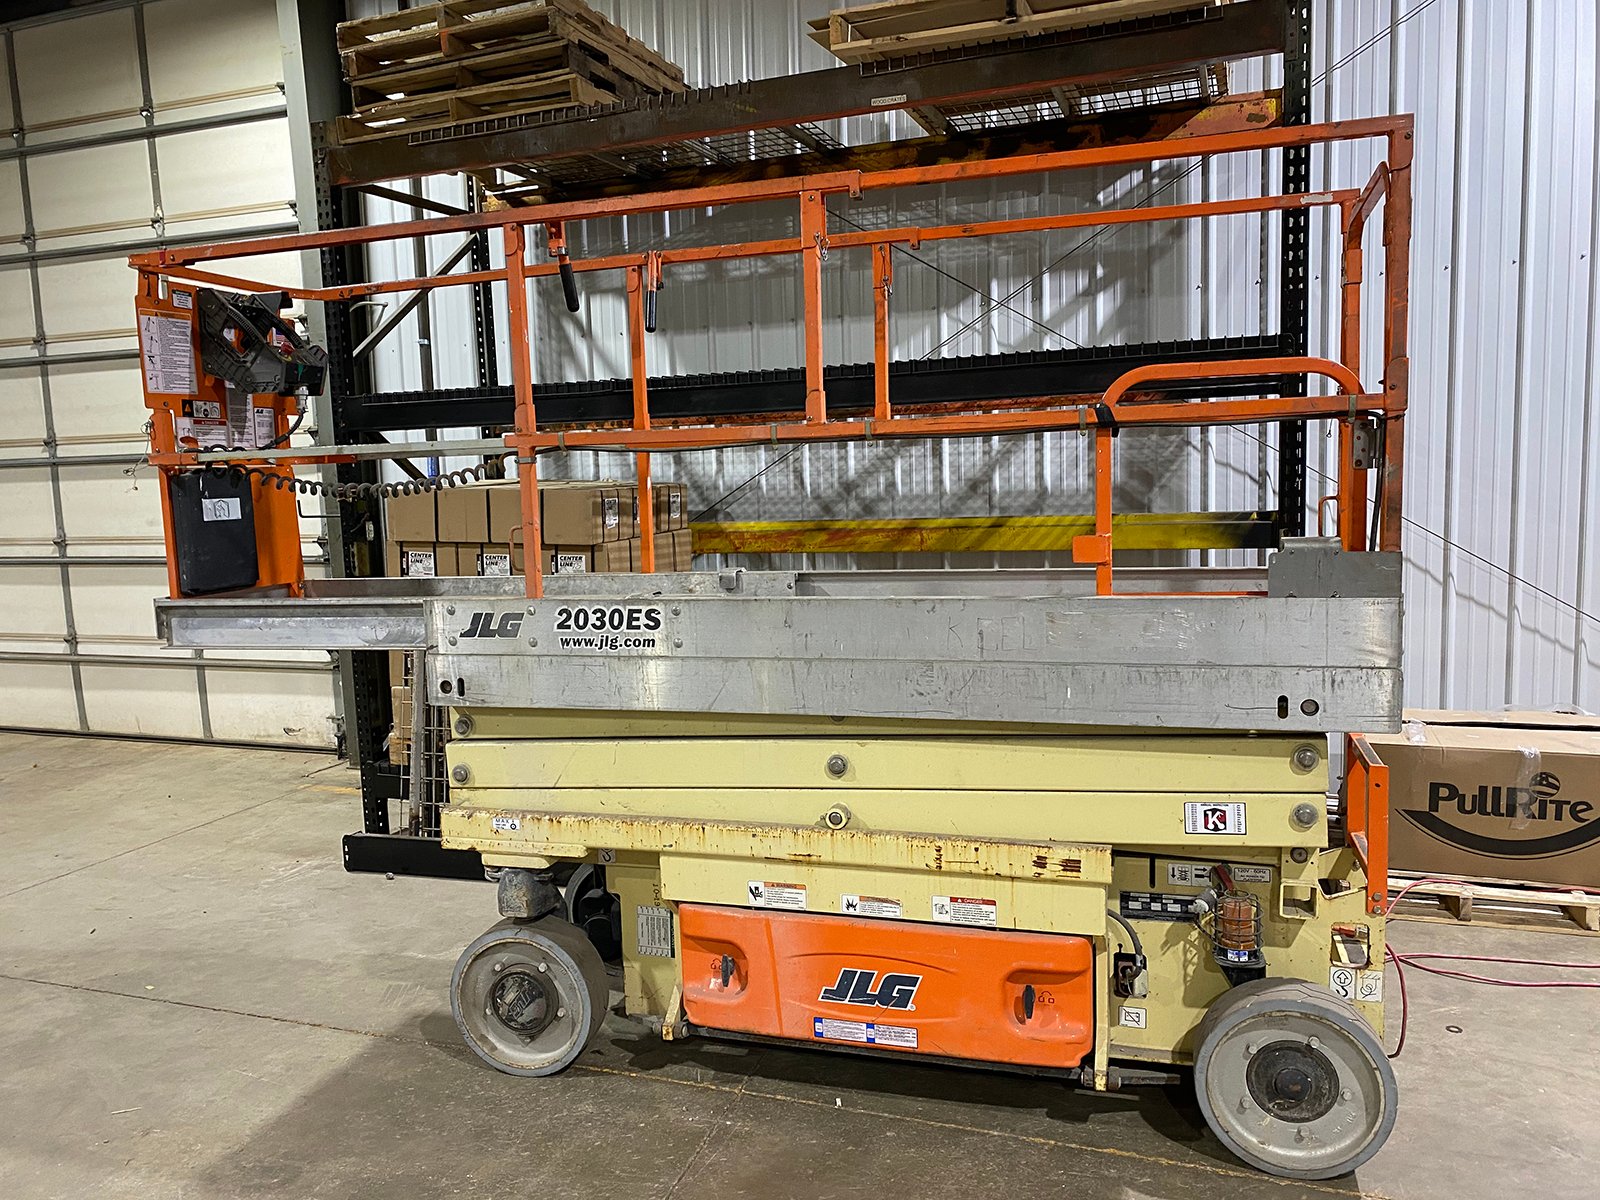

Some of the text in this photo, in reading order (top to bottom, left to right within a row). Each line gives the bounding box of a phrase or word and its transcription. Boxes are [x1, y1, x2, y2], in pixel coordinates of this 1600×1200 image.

[459, 611, 525, 638] JLG
[556, 607, 662, 631] 2030ES
[560, 635, 656, 650] www.jlg.com
[818, 968, 923, 1010] JLG
